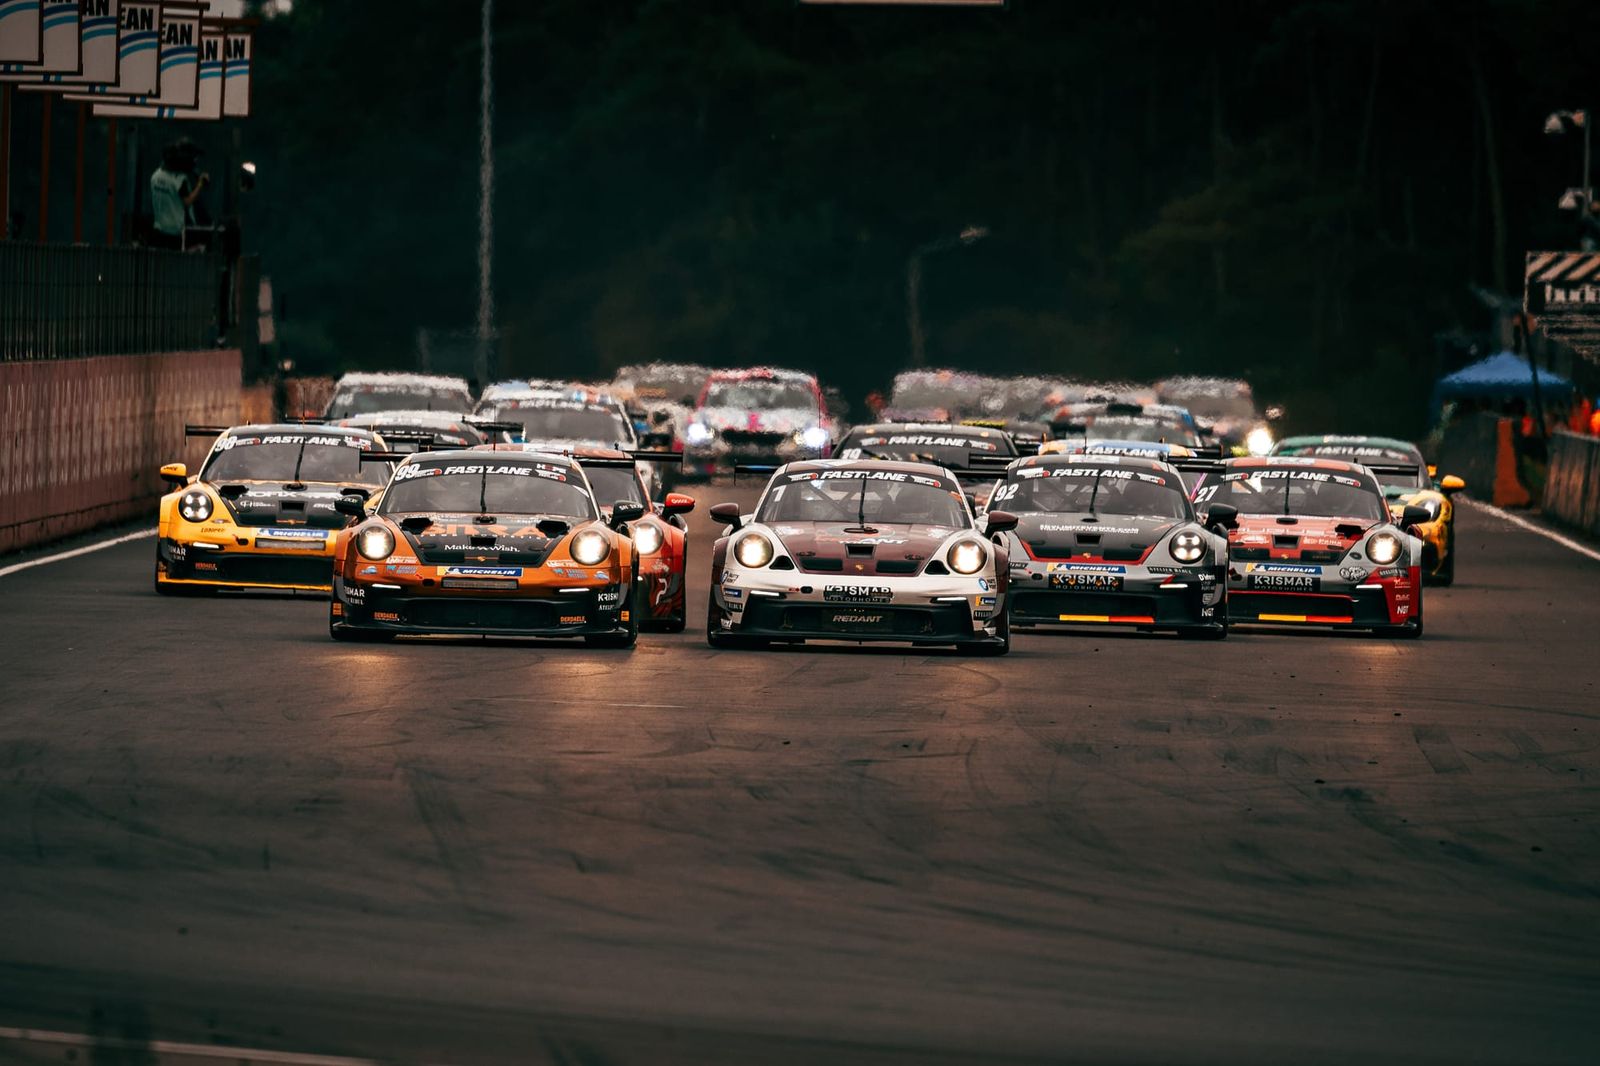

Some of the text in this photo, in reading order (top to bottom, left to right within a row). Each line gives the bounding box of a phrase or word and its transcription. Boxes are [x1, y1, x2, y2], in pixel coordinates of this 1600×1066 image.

[261, 436, 341, 446] FASTLANE
[888, 436, 966, 447] FASTLANE
[394, 463, 421, 480] 99
[443, 465, 532, 475] FASTLANE
[1052, 469, 1135, 479] FASTLANE
[820, 471, 908, 481] FASTLANE
[1252, 471, 1331, 481] FASTLANE
[772, 485, 787, 502] 1
[994, 483, 1019, 502] 92
[1194, 485, 1219, 504] 27
[1254, 576, 1313, 587] KRISMAR
[832, 615, 882, 623] REDANT
